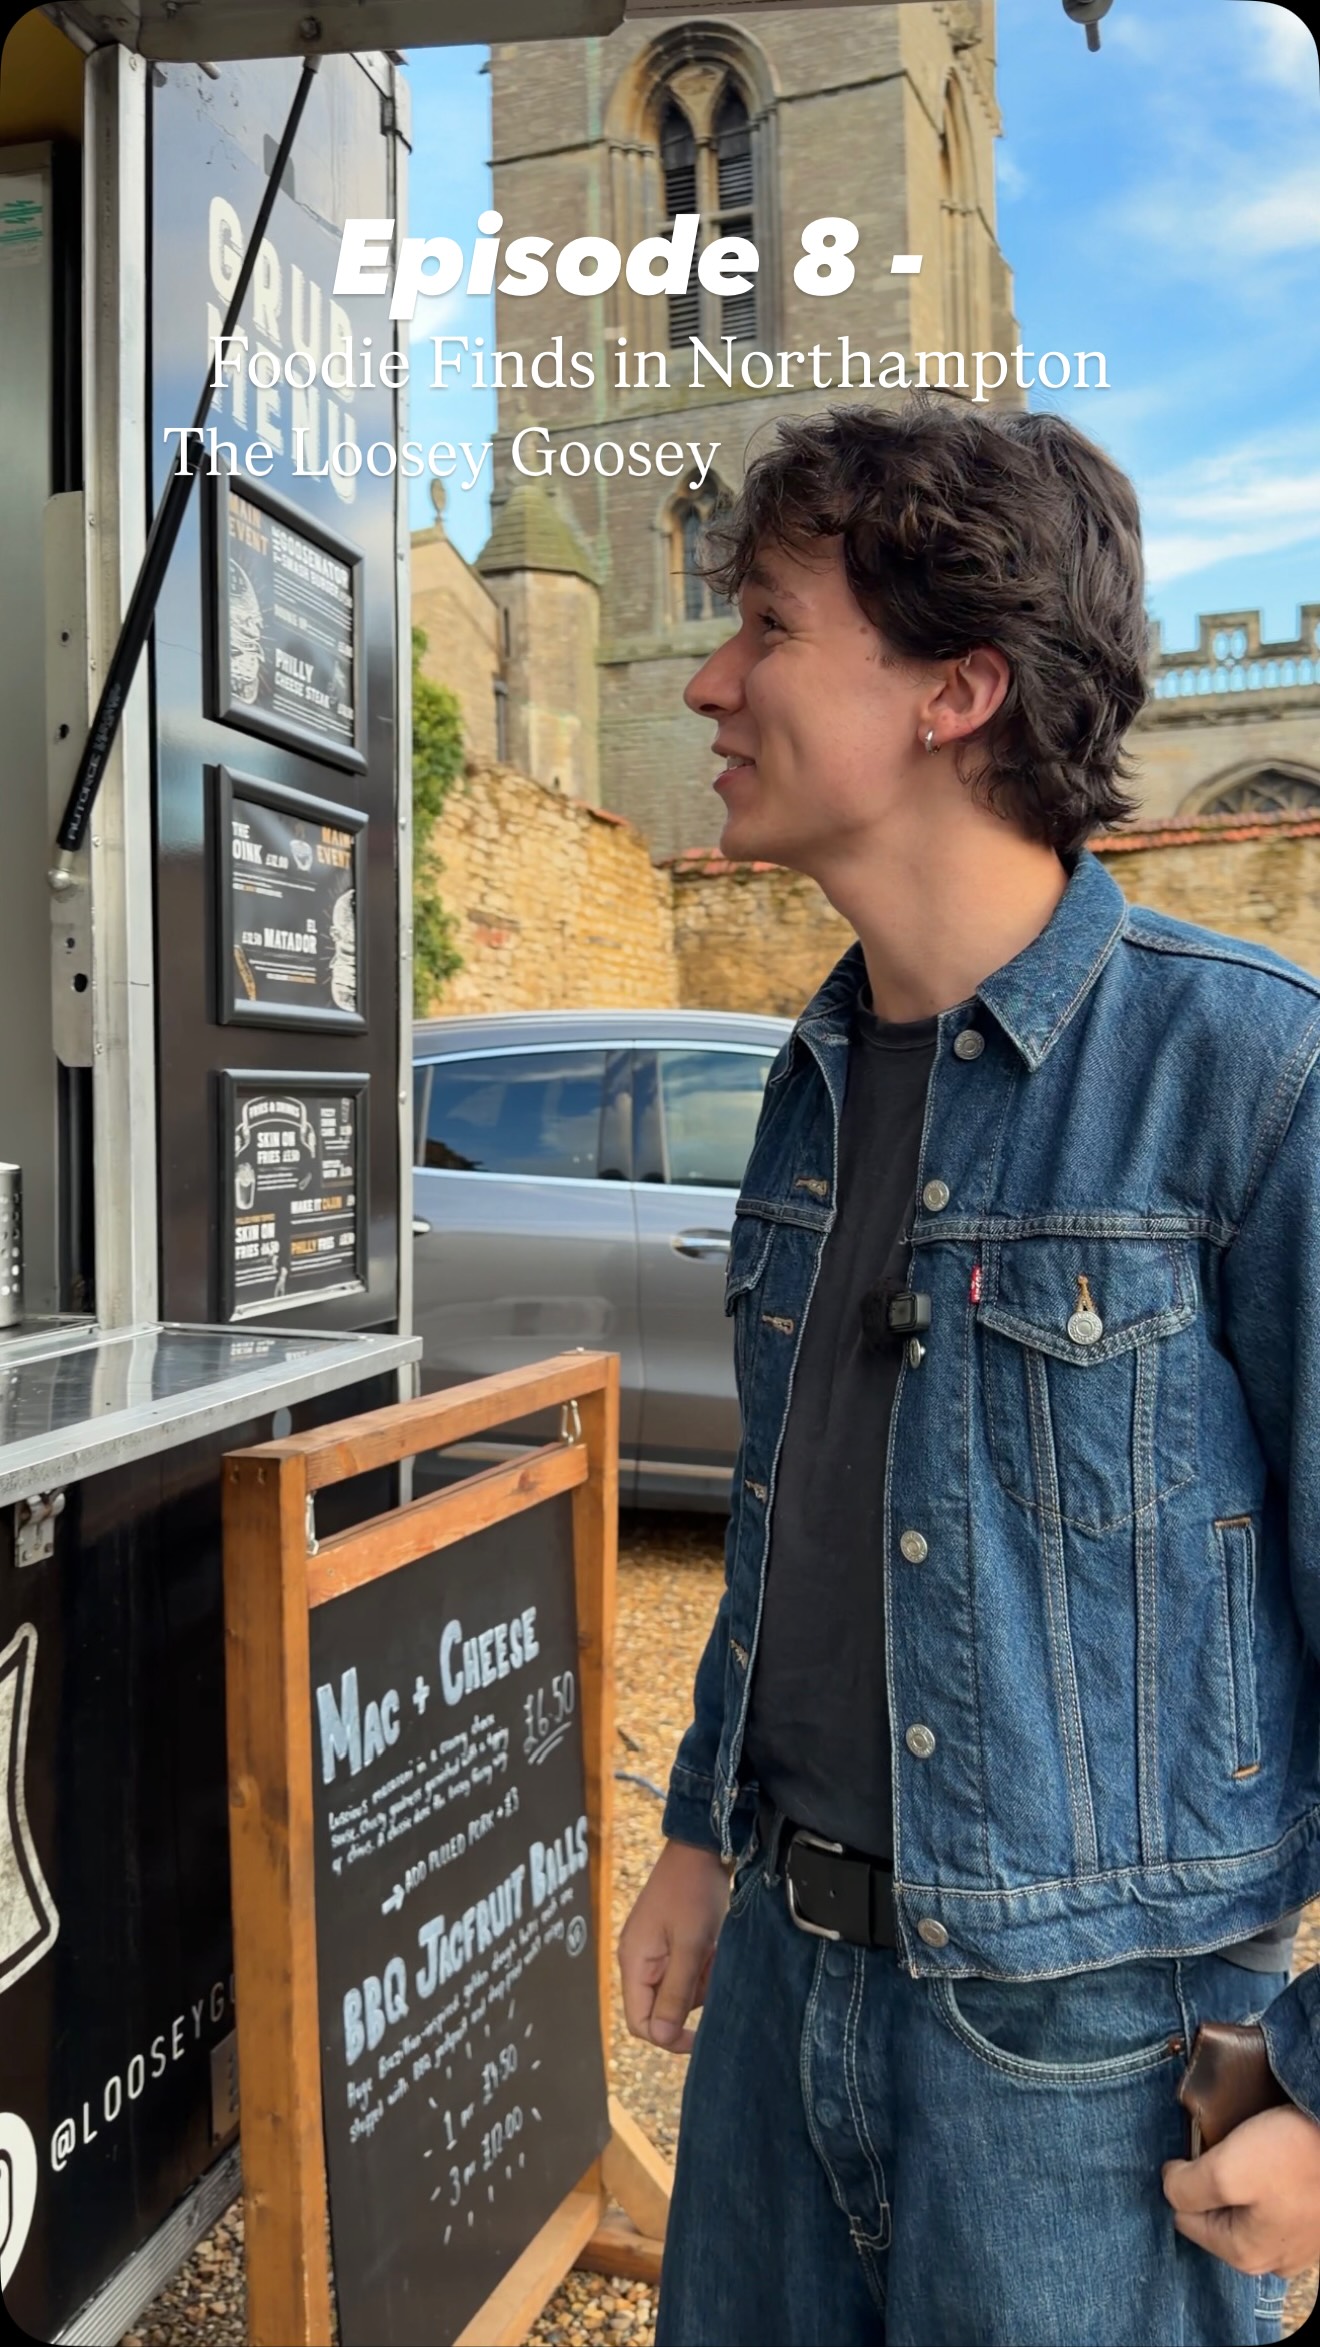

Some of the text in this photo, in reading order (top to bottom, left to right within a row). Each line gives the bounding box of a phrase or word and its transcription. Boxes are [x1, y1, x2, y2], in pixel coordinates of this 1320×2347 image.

[229, 515, 269, 556] EVENT
[275, 647, 315, 684] PHILLY
[274, 670, 304, 697] CHEESE
[231, 820, 251, 839] THE
[231, 838, 263, 864] OINK
[315, 843, 352, 870] EVENT
[263, 926, 318, 955] MATADOR
[256, 1130, 297, 1148] SKIN ON
[256, 1149, 281, 1165] FRIES
[234, 1221, 276, 1244] SKIN ON
[234, 1243, 260, 1261] FRIES
[290, 1238, 318, 1256] PHILLY
[412, 1674, 431, 1716] +
[438, 1604, 541, 1707] CHEESE
[522, 1669, 576, 1755] £6.50
[404, 1859, 428, 1893] ADD
[427, 1832, 467, 1873] PULLED
[466, 1809, 495, 1846] PORK
[342, 1814, 590, 2067] BBQ JACFRUIT BALLS
[448, 2165, 462, 2207] 3
